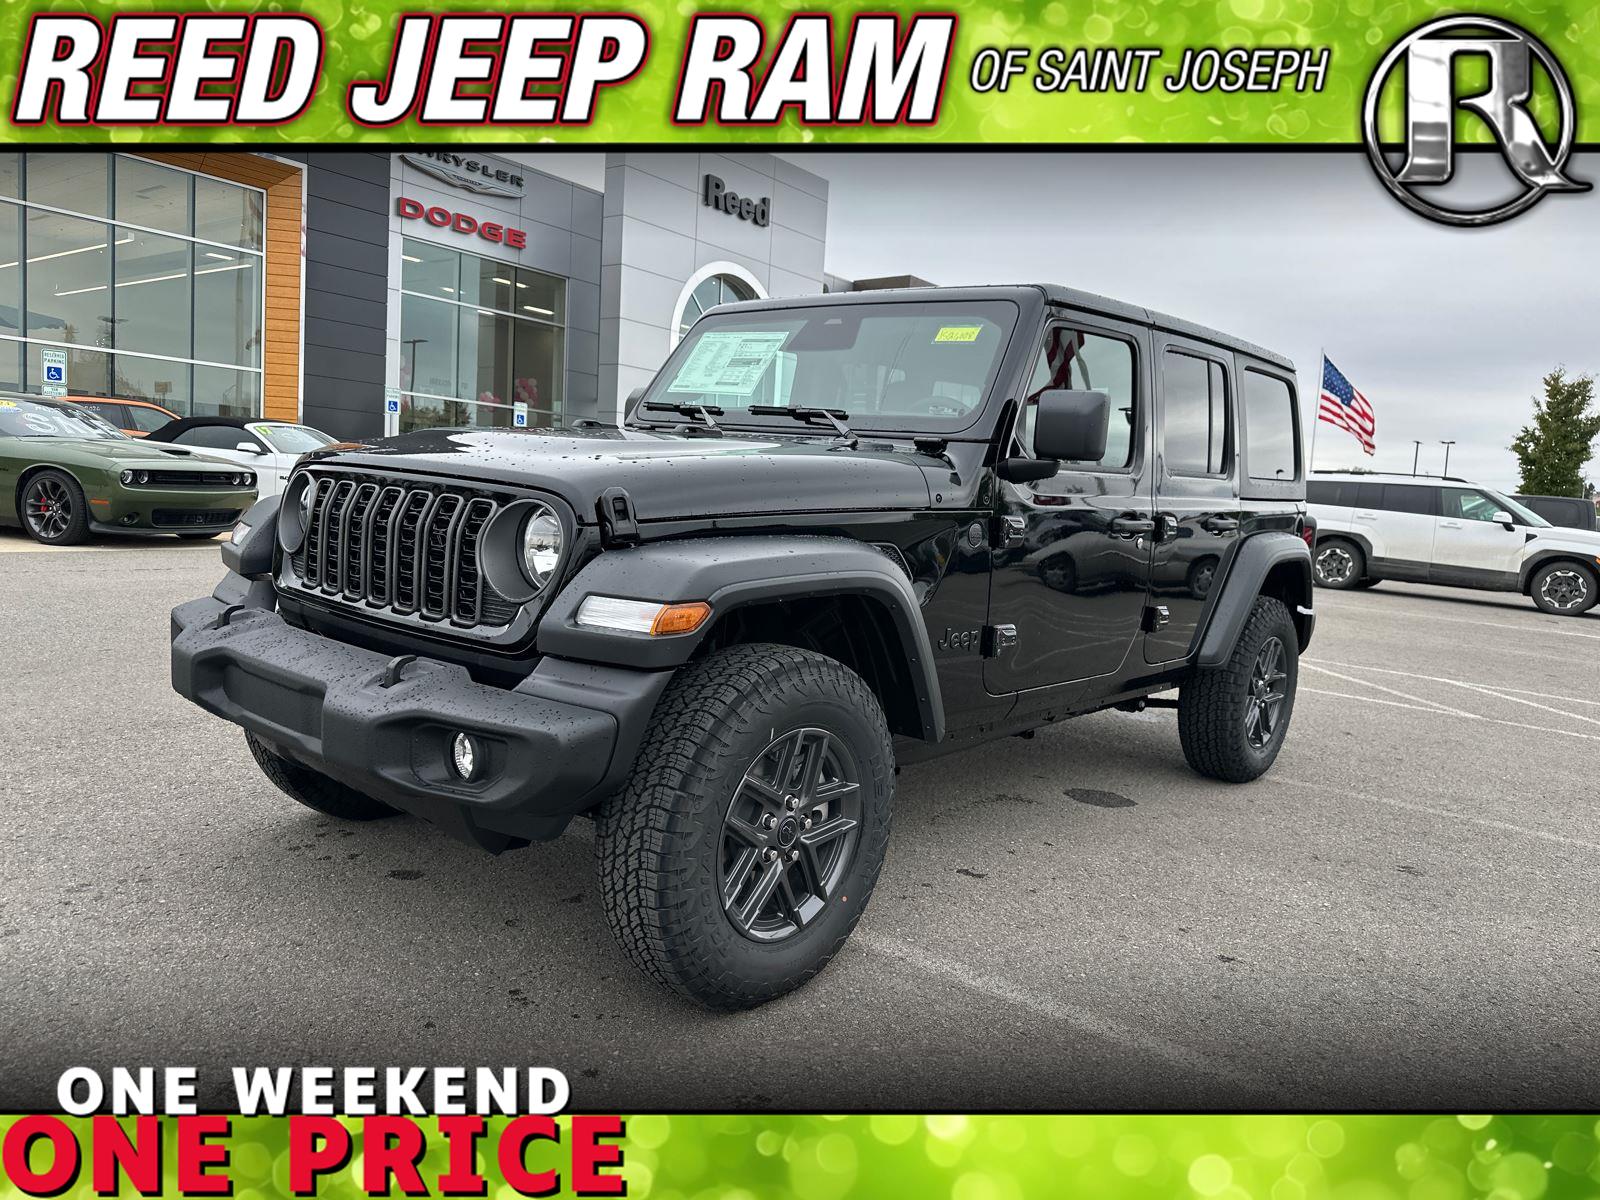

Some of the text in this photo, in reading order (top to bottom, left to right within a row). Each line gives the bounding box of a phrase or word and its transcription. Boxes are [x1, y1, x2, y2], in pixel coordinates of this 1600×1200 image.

[397, 197, 527, 249] DODGE
[704, 174, 771, 228] Reed
[938, 627, 979, 651] Jeep
